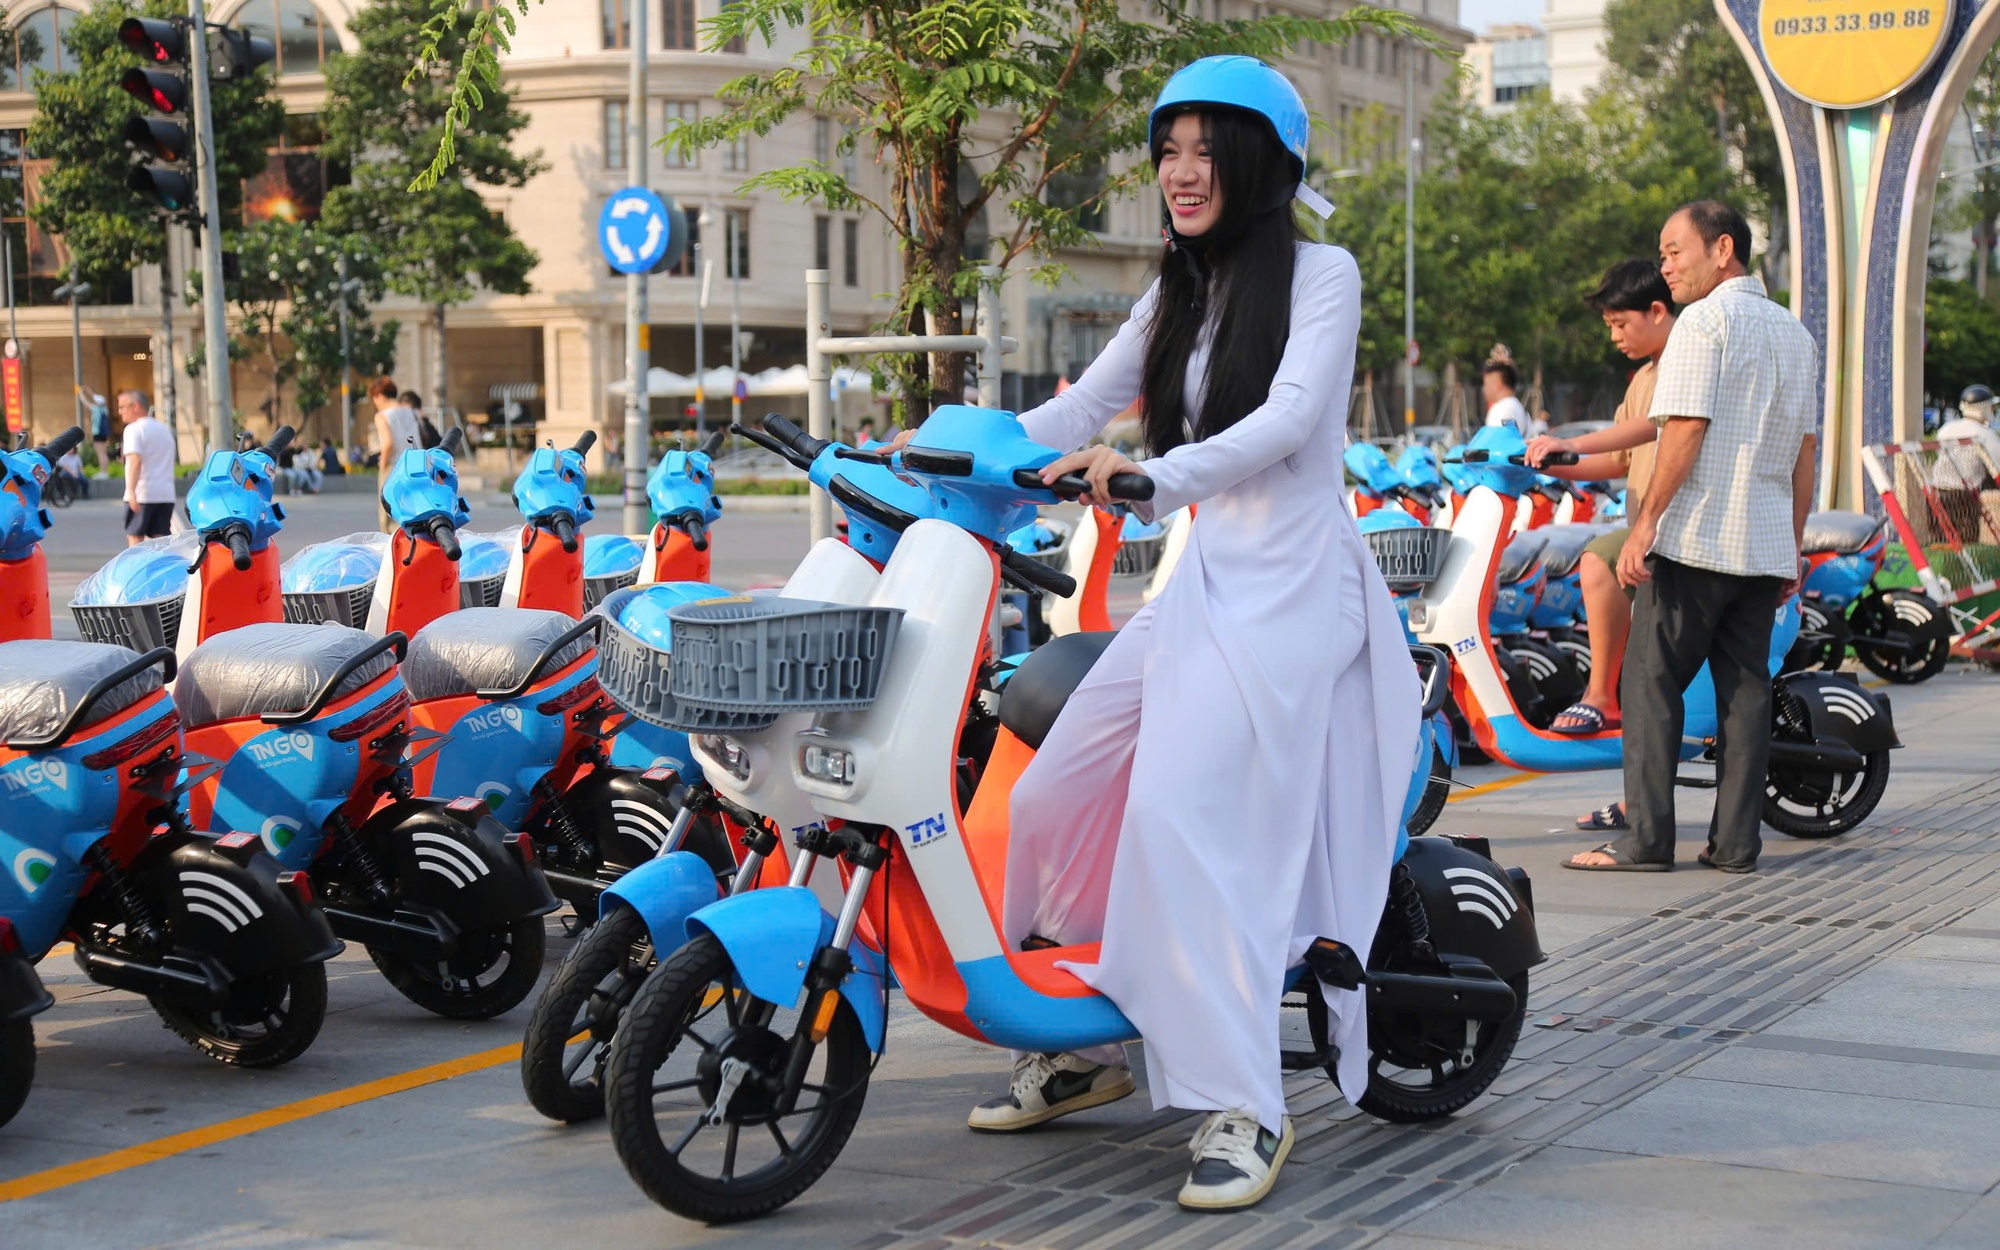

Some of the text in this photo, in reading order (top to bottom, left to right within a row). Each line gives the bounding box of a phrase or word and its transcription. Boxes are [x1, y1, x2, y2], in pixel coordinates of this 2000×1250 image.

[1774, 9, 1931, 36] 0933.33.99.88
[1454, 635, 1476, 653] TN
[905, 813, 946, 843] TN
